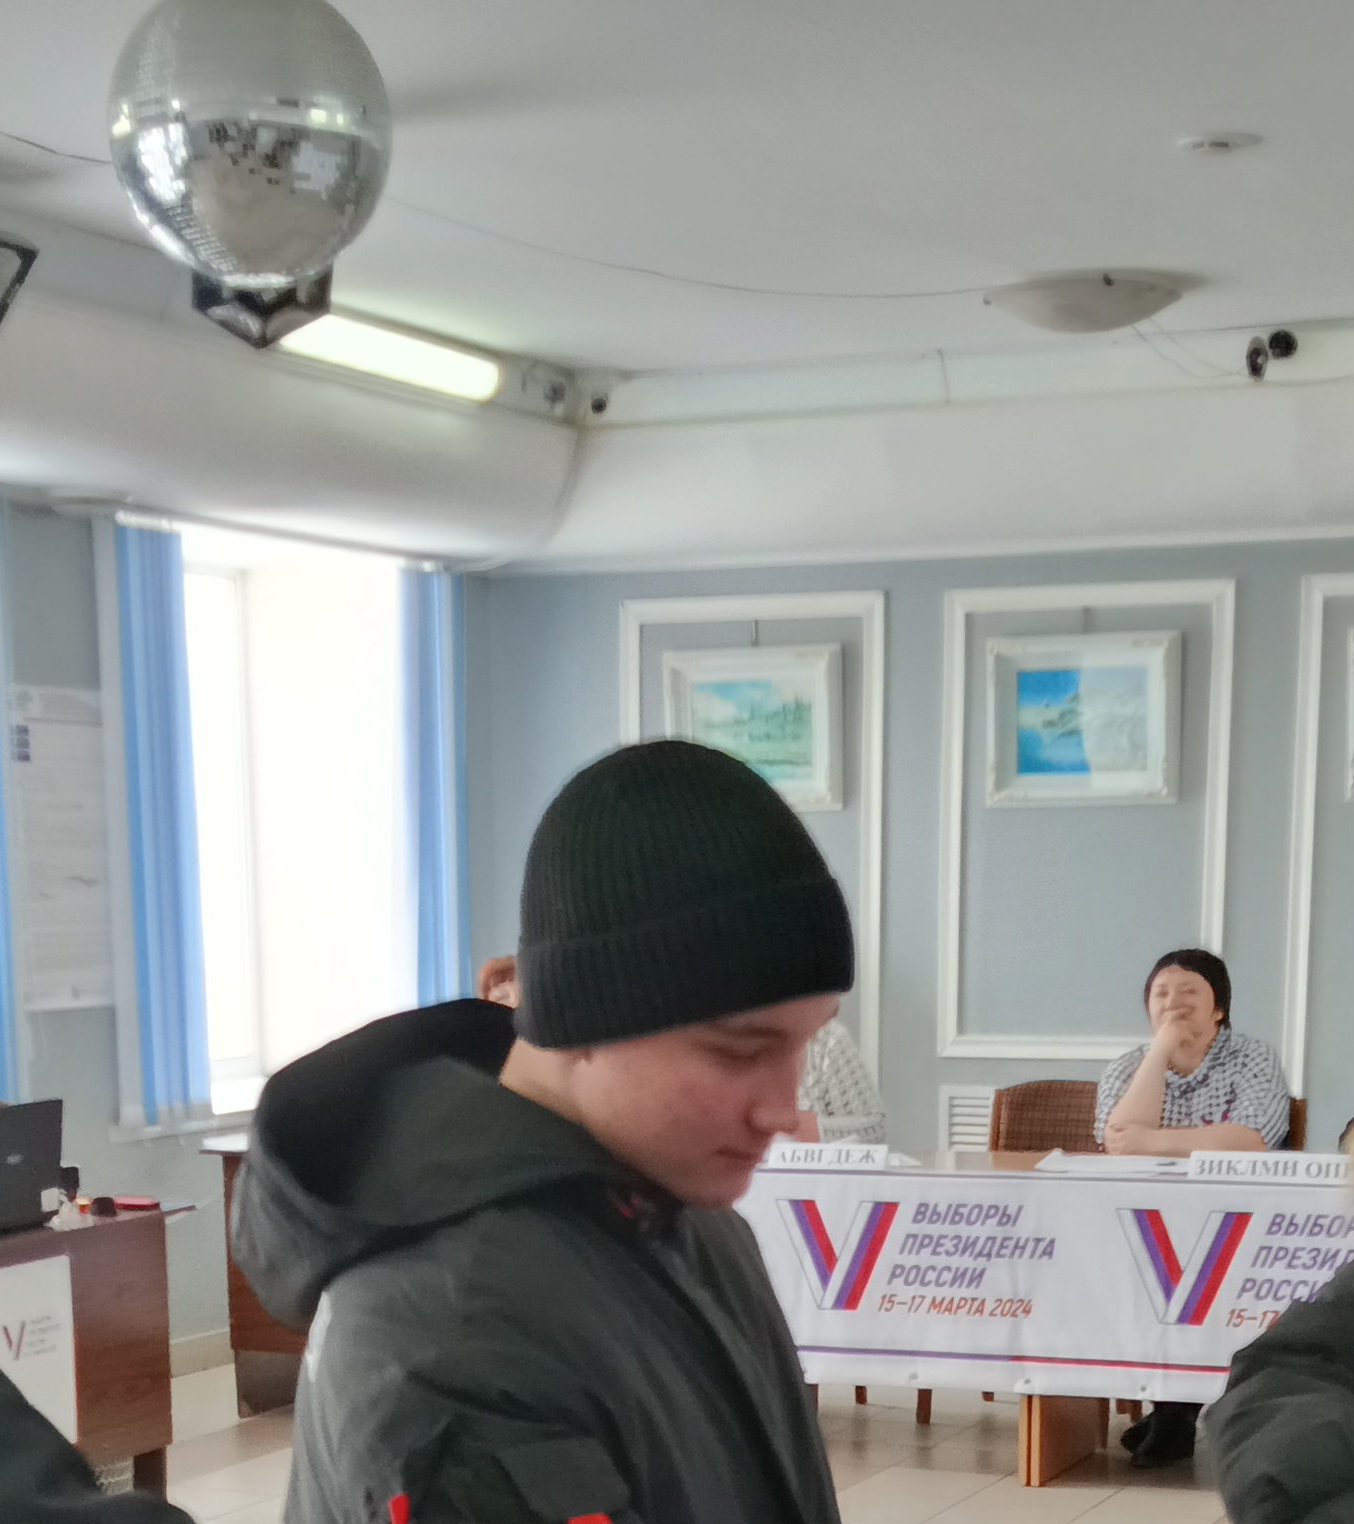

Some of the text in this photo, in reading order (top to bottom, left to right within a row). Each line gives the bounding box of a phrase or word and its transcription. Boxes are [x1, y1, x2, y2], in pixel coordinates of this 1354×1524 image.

[911, 1202, 1023, 1228] ВЫБОРЫ
[899, 1233, 1056, 1261] ПРЕЗИДЕНТА
[887, 1264, 987, 1290] РОССИИ
[928, 1296, 987, 1317] МАРТА
[988, 1298, 1033, 1319] 2024
